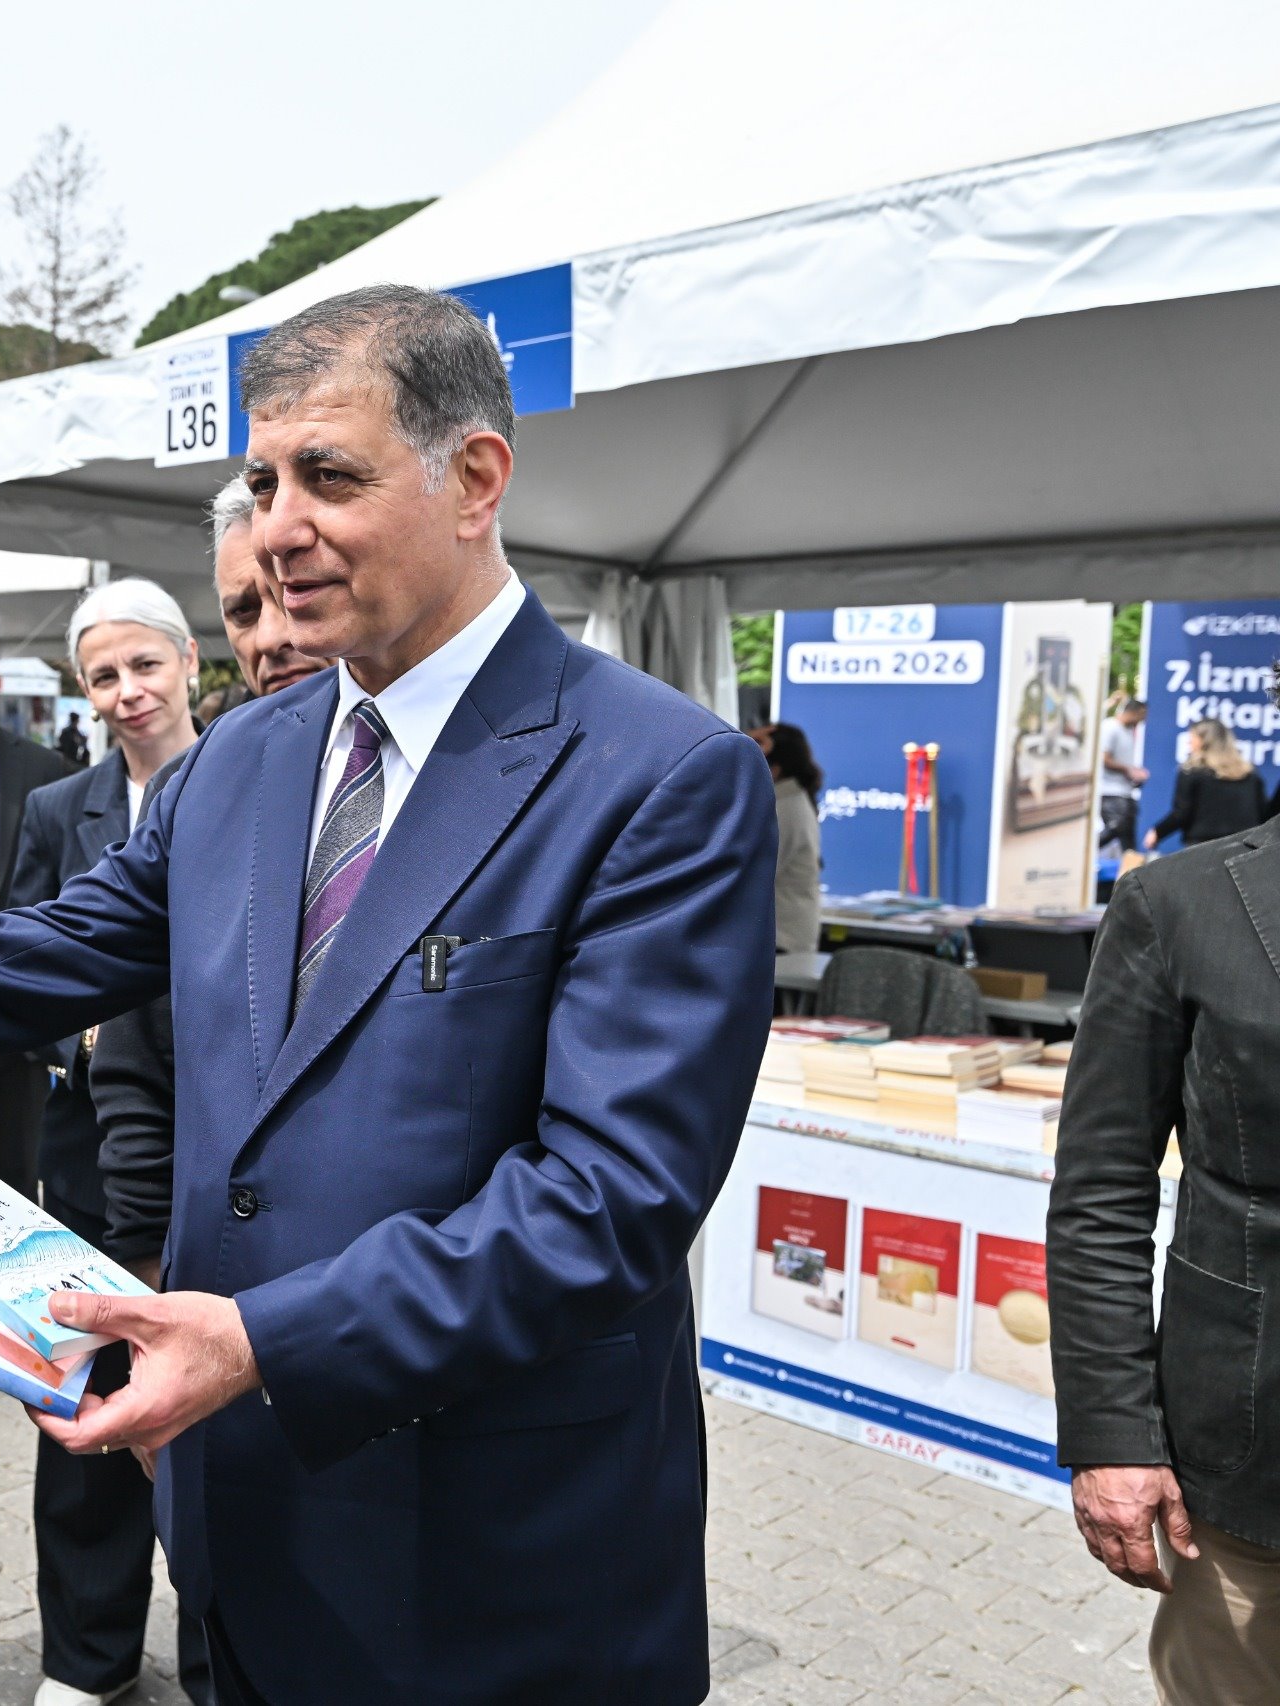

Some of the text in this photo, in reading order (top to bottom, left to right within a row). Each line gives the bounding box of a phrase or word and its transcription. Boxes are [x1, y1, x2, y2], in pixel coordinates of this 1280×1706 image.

[167, 402, 216, 452] L36
[847, 612, 923, 635] 17-26
[800, 652, 968, 675] Nisan 2026
[866, 1425, 947, 1462] SARAY
